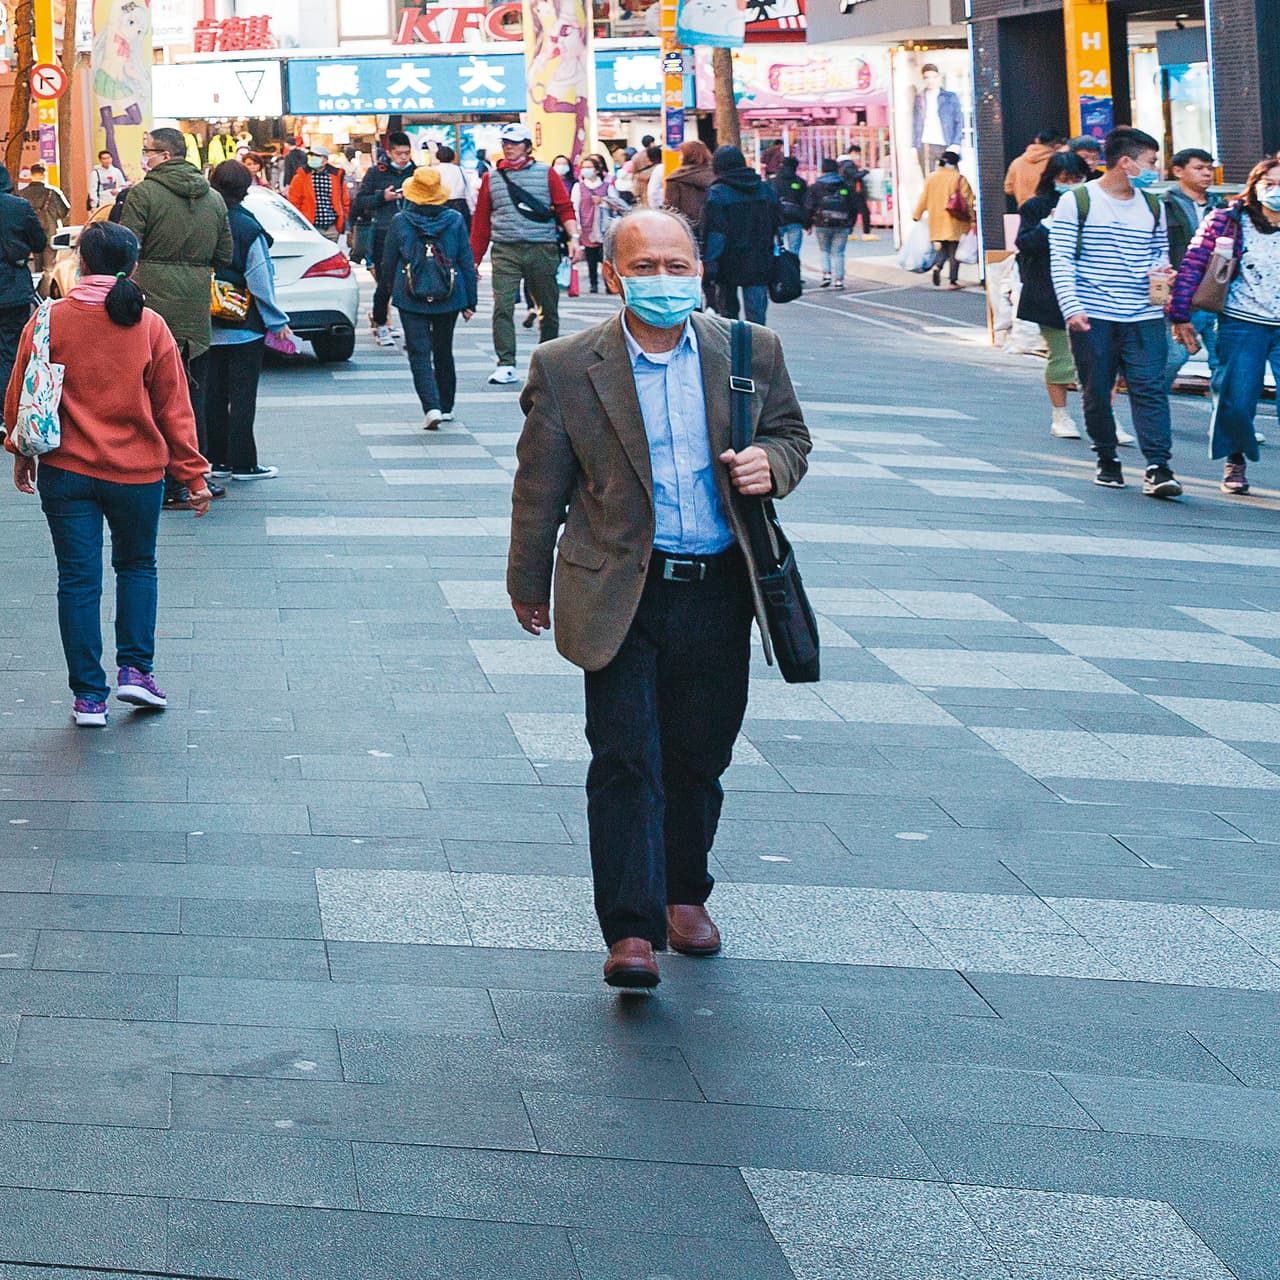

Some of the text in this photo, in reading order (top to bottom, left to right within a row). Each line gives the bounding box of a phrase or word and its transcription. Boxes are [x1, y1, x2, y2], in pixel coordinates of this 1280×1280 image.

[392, 2, 523, 45] KFC
[193, 15, 272, 52] 肯德基
[1081, 32, 1101, 50] H
[1079, 70, 1108, 88] 24
[319, 96, 506, 111] HOT-STAR Large
[606, 93, 663, 104] Chicke
